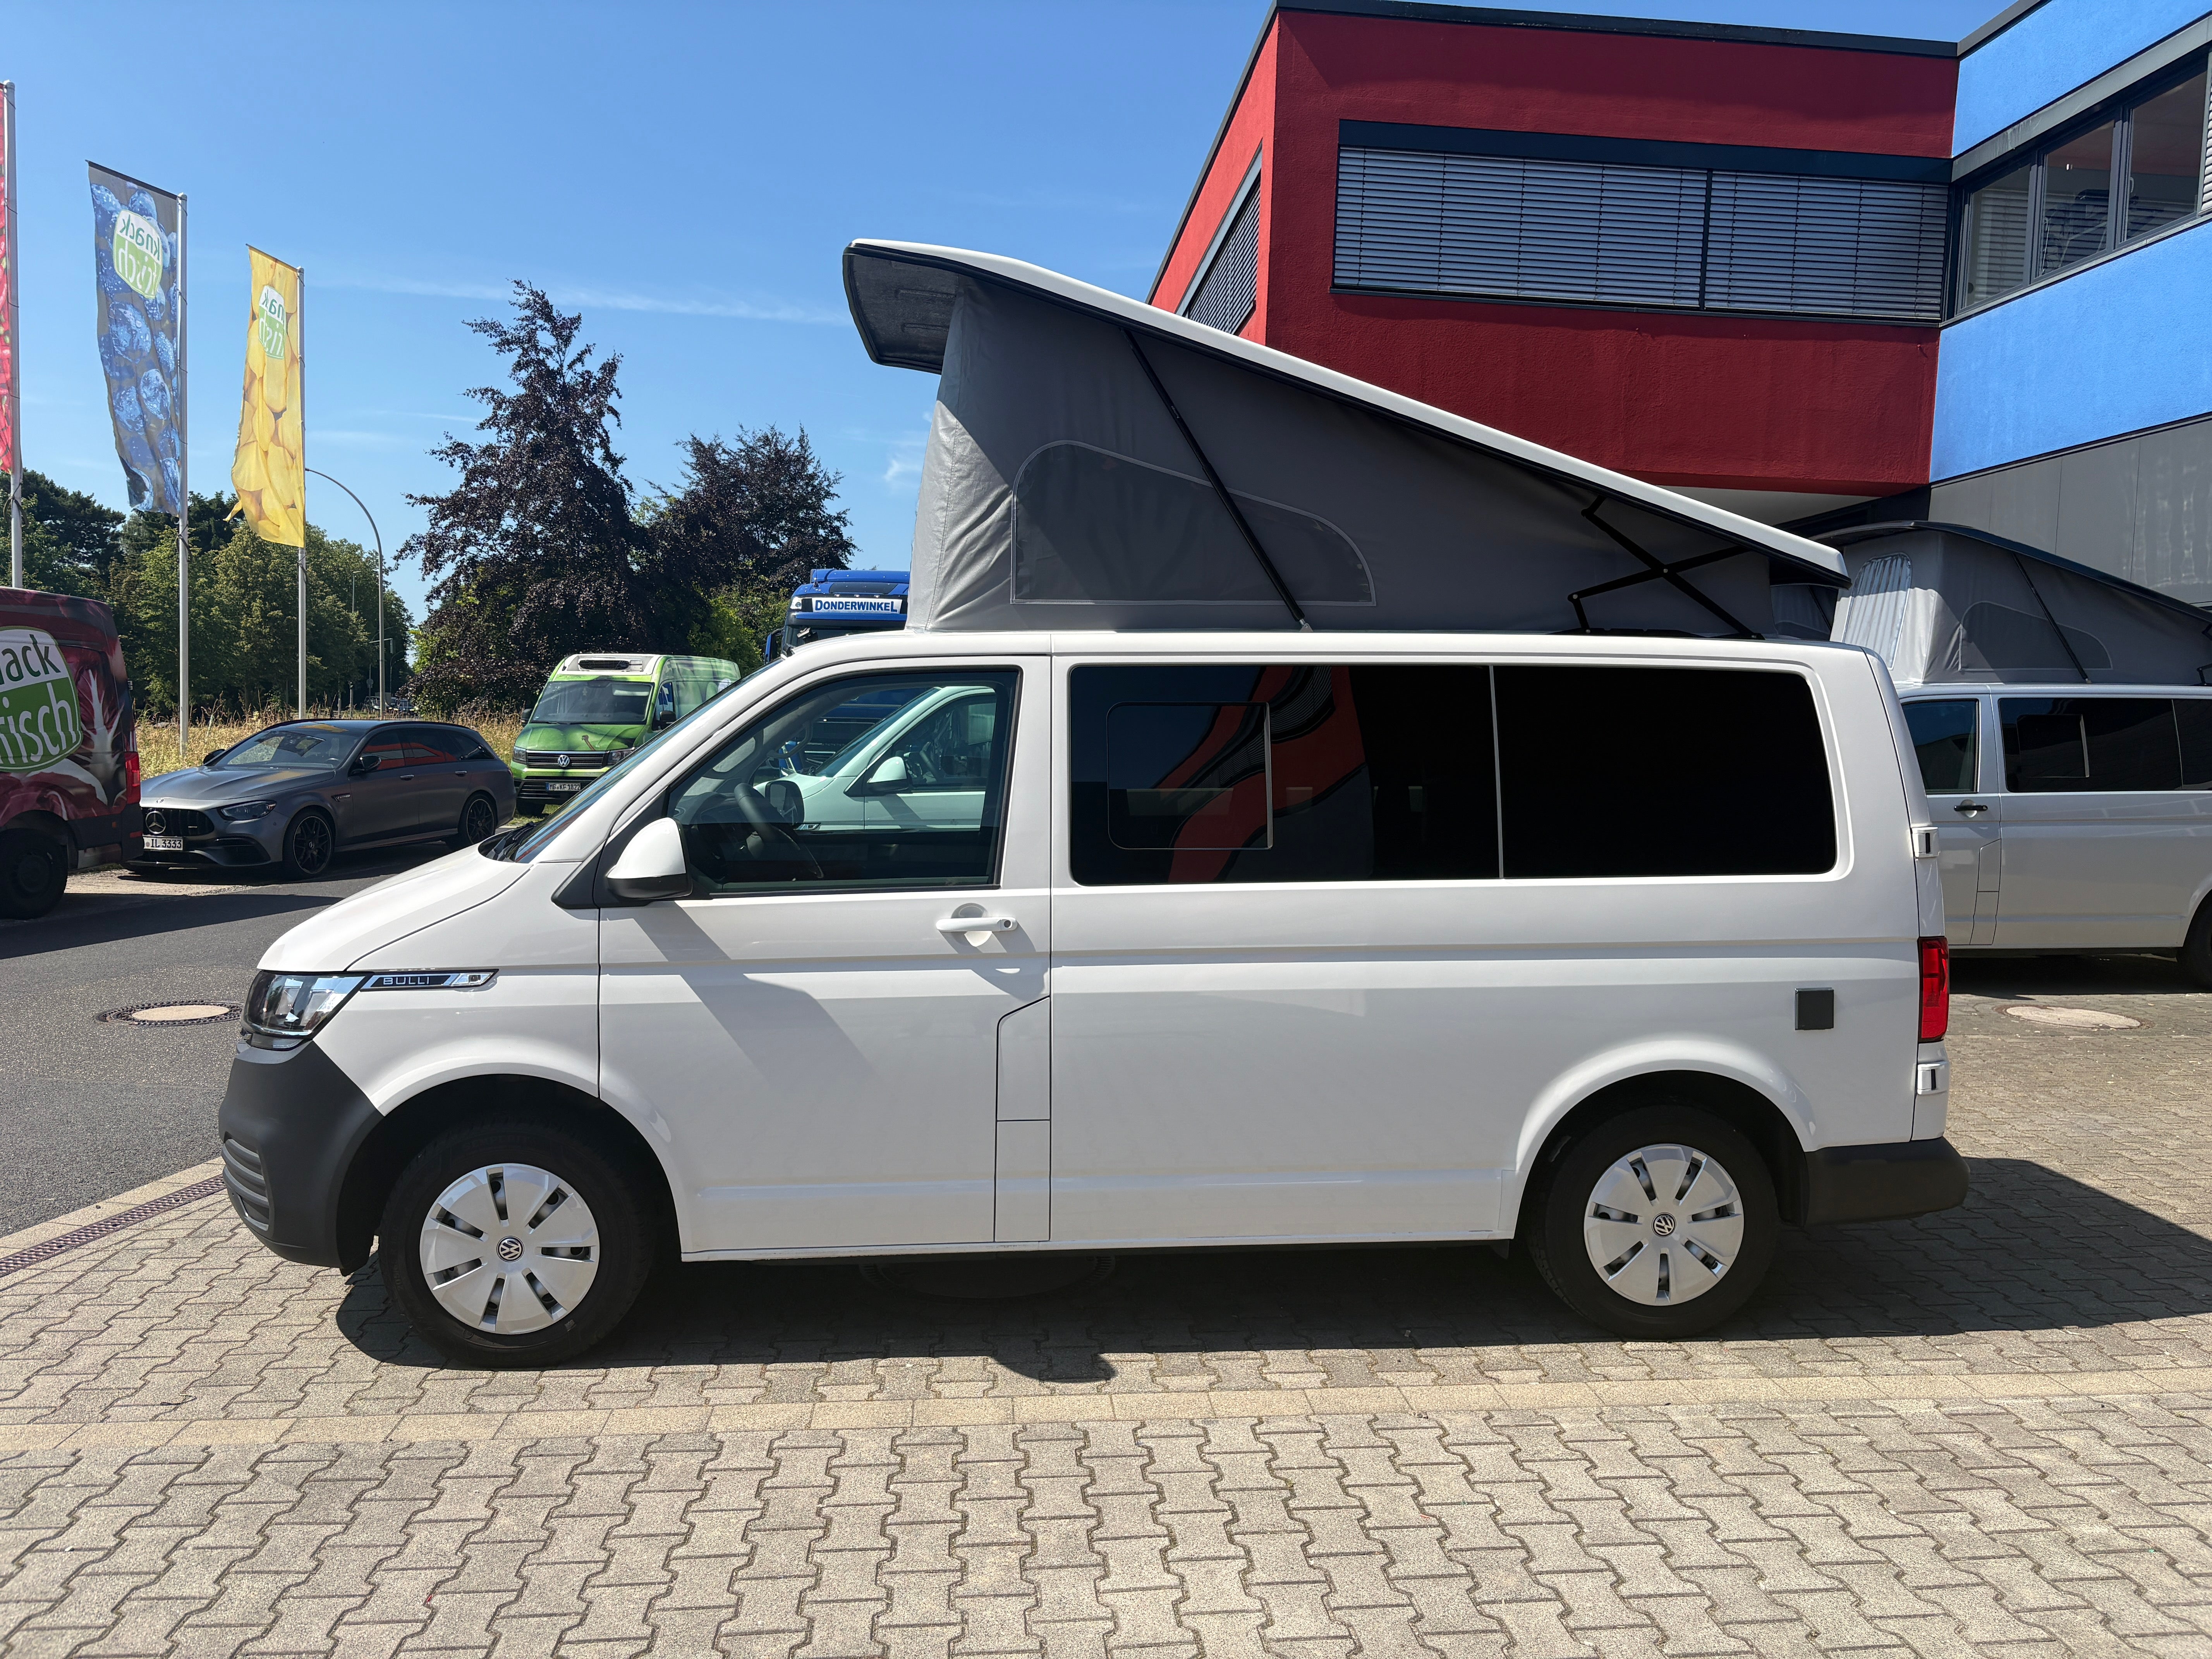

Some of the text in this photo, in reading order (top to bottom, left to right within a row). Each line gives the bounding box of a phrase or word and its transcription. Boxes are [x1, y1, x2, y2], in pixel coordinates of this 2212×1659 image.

[815, 600, 898, 613] DONDERWINKEL
[0, 682, 76, 764] risch
[151, 838, 182, 849] IL 3333
[383, 976, 430, 985] BULLI
